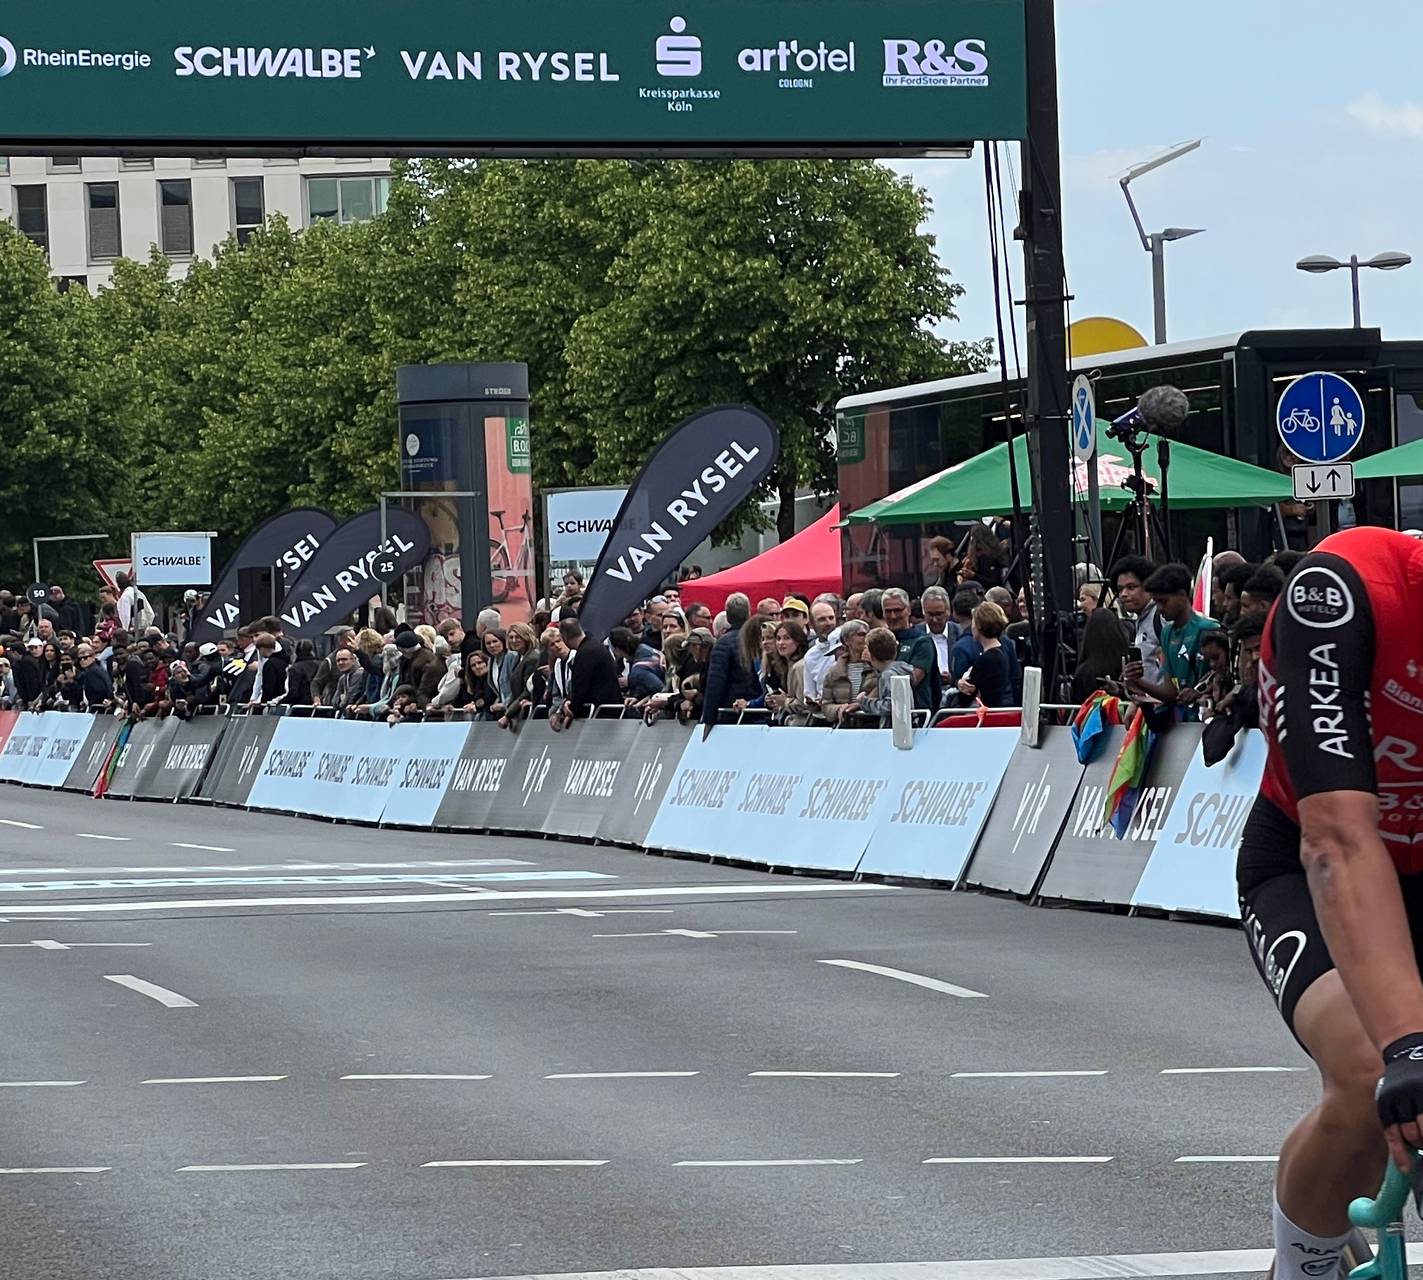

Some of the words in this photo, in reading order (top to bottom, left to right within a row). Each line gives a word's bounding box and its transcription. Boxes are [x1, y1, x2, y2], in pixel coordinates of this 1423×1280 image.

[23, 48, 151, 71] RheinEnergie
[173, 46, 362, 78] SCHWALBE
[400, 51, 482, 80] VAN
[498, 51, 620, 81] RYSEL
[883, 39, 989, 75] R&S
[639, 87, 721, 99] Kreissparkasse
[778, 78, 814, 88] COLOGNE
[885, 76, 898, 85] Ihr
[950, 76, 986, 85] Partner
[667, 100, 693, 112] Köln
[605, 521, 673, 582] VAN
[666, 441, 760, 526] RYSEL
[143, 556, 201, 566] SCHWALBE
[380, 562, 394, 572] 25
[33, 590, 45, 598] 50
[281, 585, 336, 628] VAN
[1293, 585, 1343, 607] B&B
[1298, 605, 1339, 615] HOTELS
[206, 594, 240, 629] VA
[1309, 643, 1355, 759] ARKEA
[165, 745, 189, 769] VAN
[452, 758, 479, 790] VAN
[472, 759, 507, 792] RYSEL
[564, 760, 591, 794] VAN
[583, 761, 621, 797] RYSEL
[669, 769, 736, 809] SCHWALBE
[738, 773, 799, 815] SCHWALBE
[800, 778, 884, 821] SCHWALBE
[891, 780, 983, 826] SCHWALBE
[1174, 792, 1257, 850] SCHW
